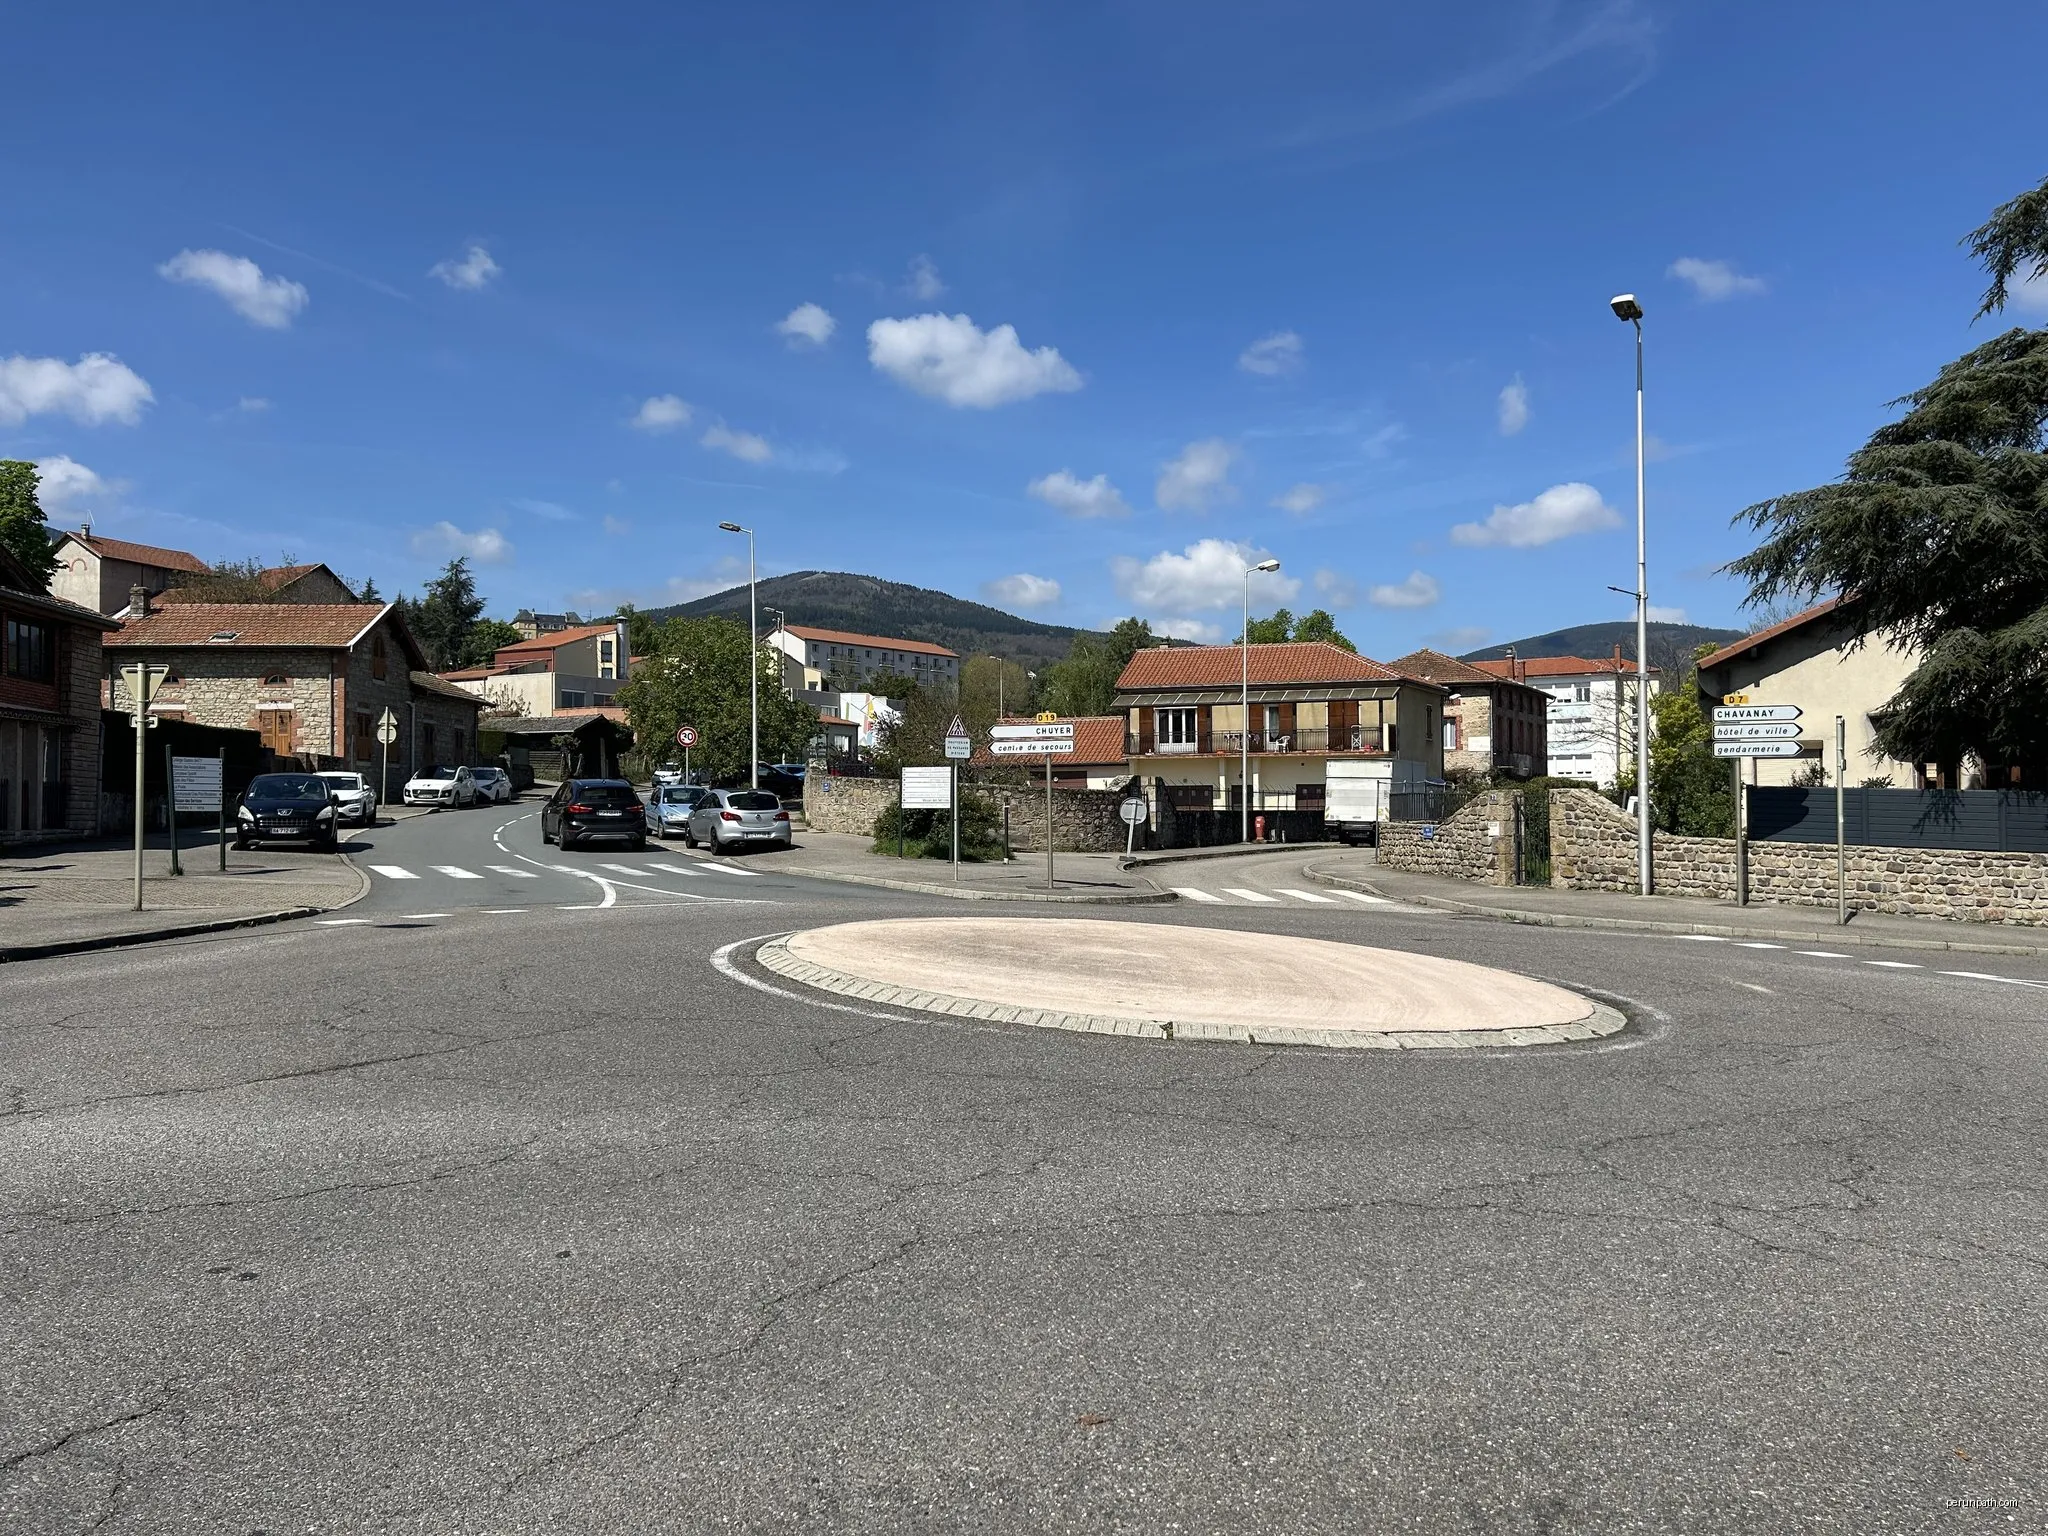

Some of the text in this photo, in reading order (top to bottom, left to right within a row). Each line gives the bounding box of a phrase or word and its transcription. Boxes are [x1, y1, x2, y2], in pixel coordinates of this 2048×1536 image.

[1729, 695, 1744, 704] D 7
[1037, 714, 1043, 722] D
[1717, 709, 1774, 718] CHAVANAY
[1035, 726, 1071, 735] CHUYER
[1717, 727, 1788, 736] hôtel de ville
[681, 732, 694, 741] 30
[1027, 743, 1037, 752] de
[1040, 743, 1072, 751] secours
[1717, 744, 1781, 755] gendarmerie
